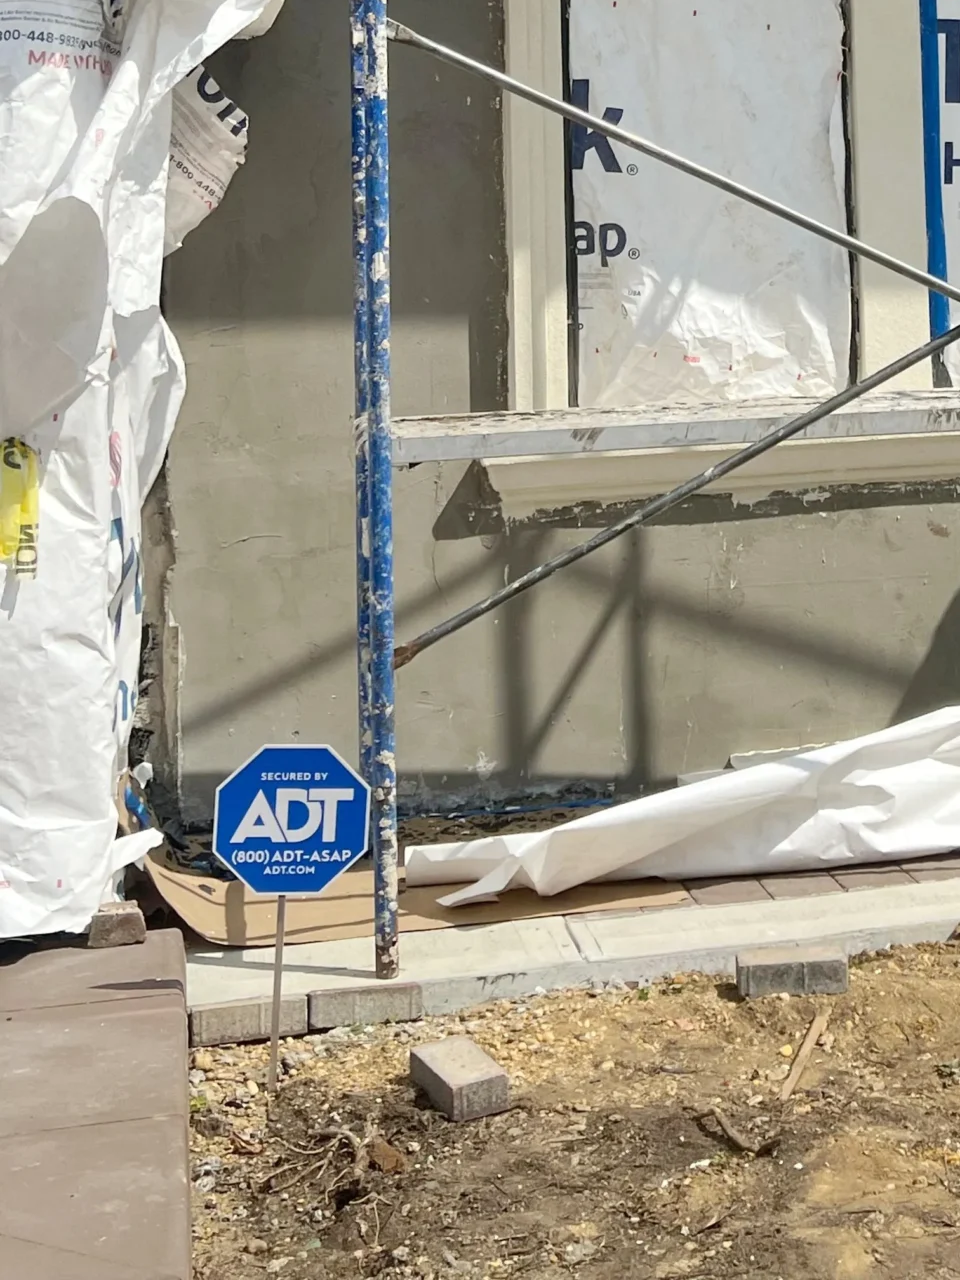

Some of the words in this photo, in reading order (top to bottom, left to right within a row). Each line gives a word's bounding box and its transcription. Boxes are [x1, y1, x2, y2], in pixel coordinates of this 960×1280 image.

[260, 772, 311, 781] SECURED
[314, 772, 328, 781] BY
[229, 788, 355, 843] ADT
[231, 849, 270, 865] (800)
[271, 849, 352, 863] ADT-ASAP
[263, 865, 315, 875] ADT.COM
